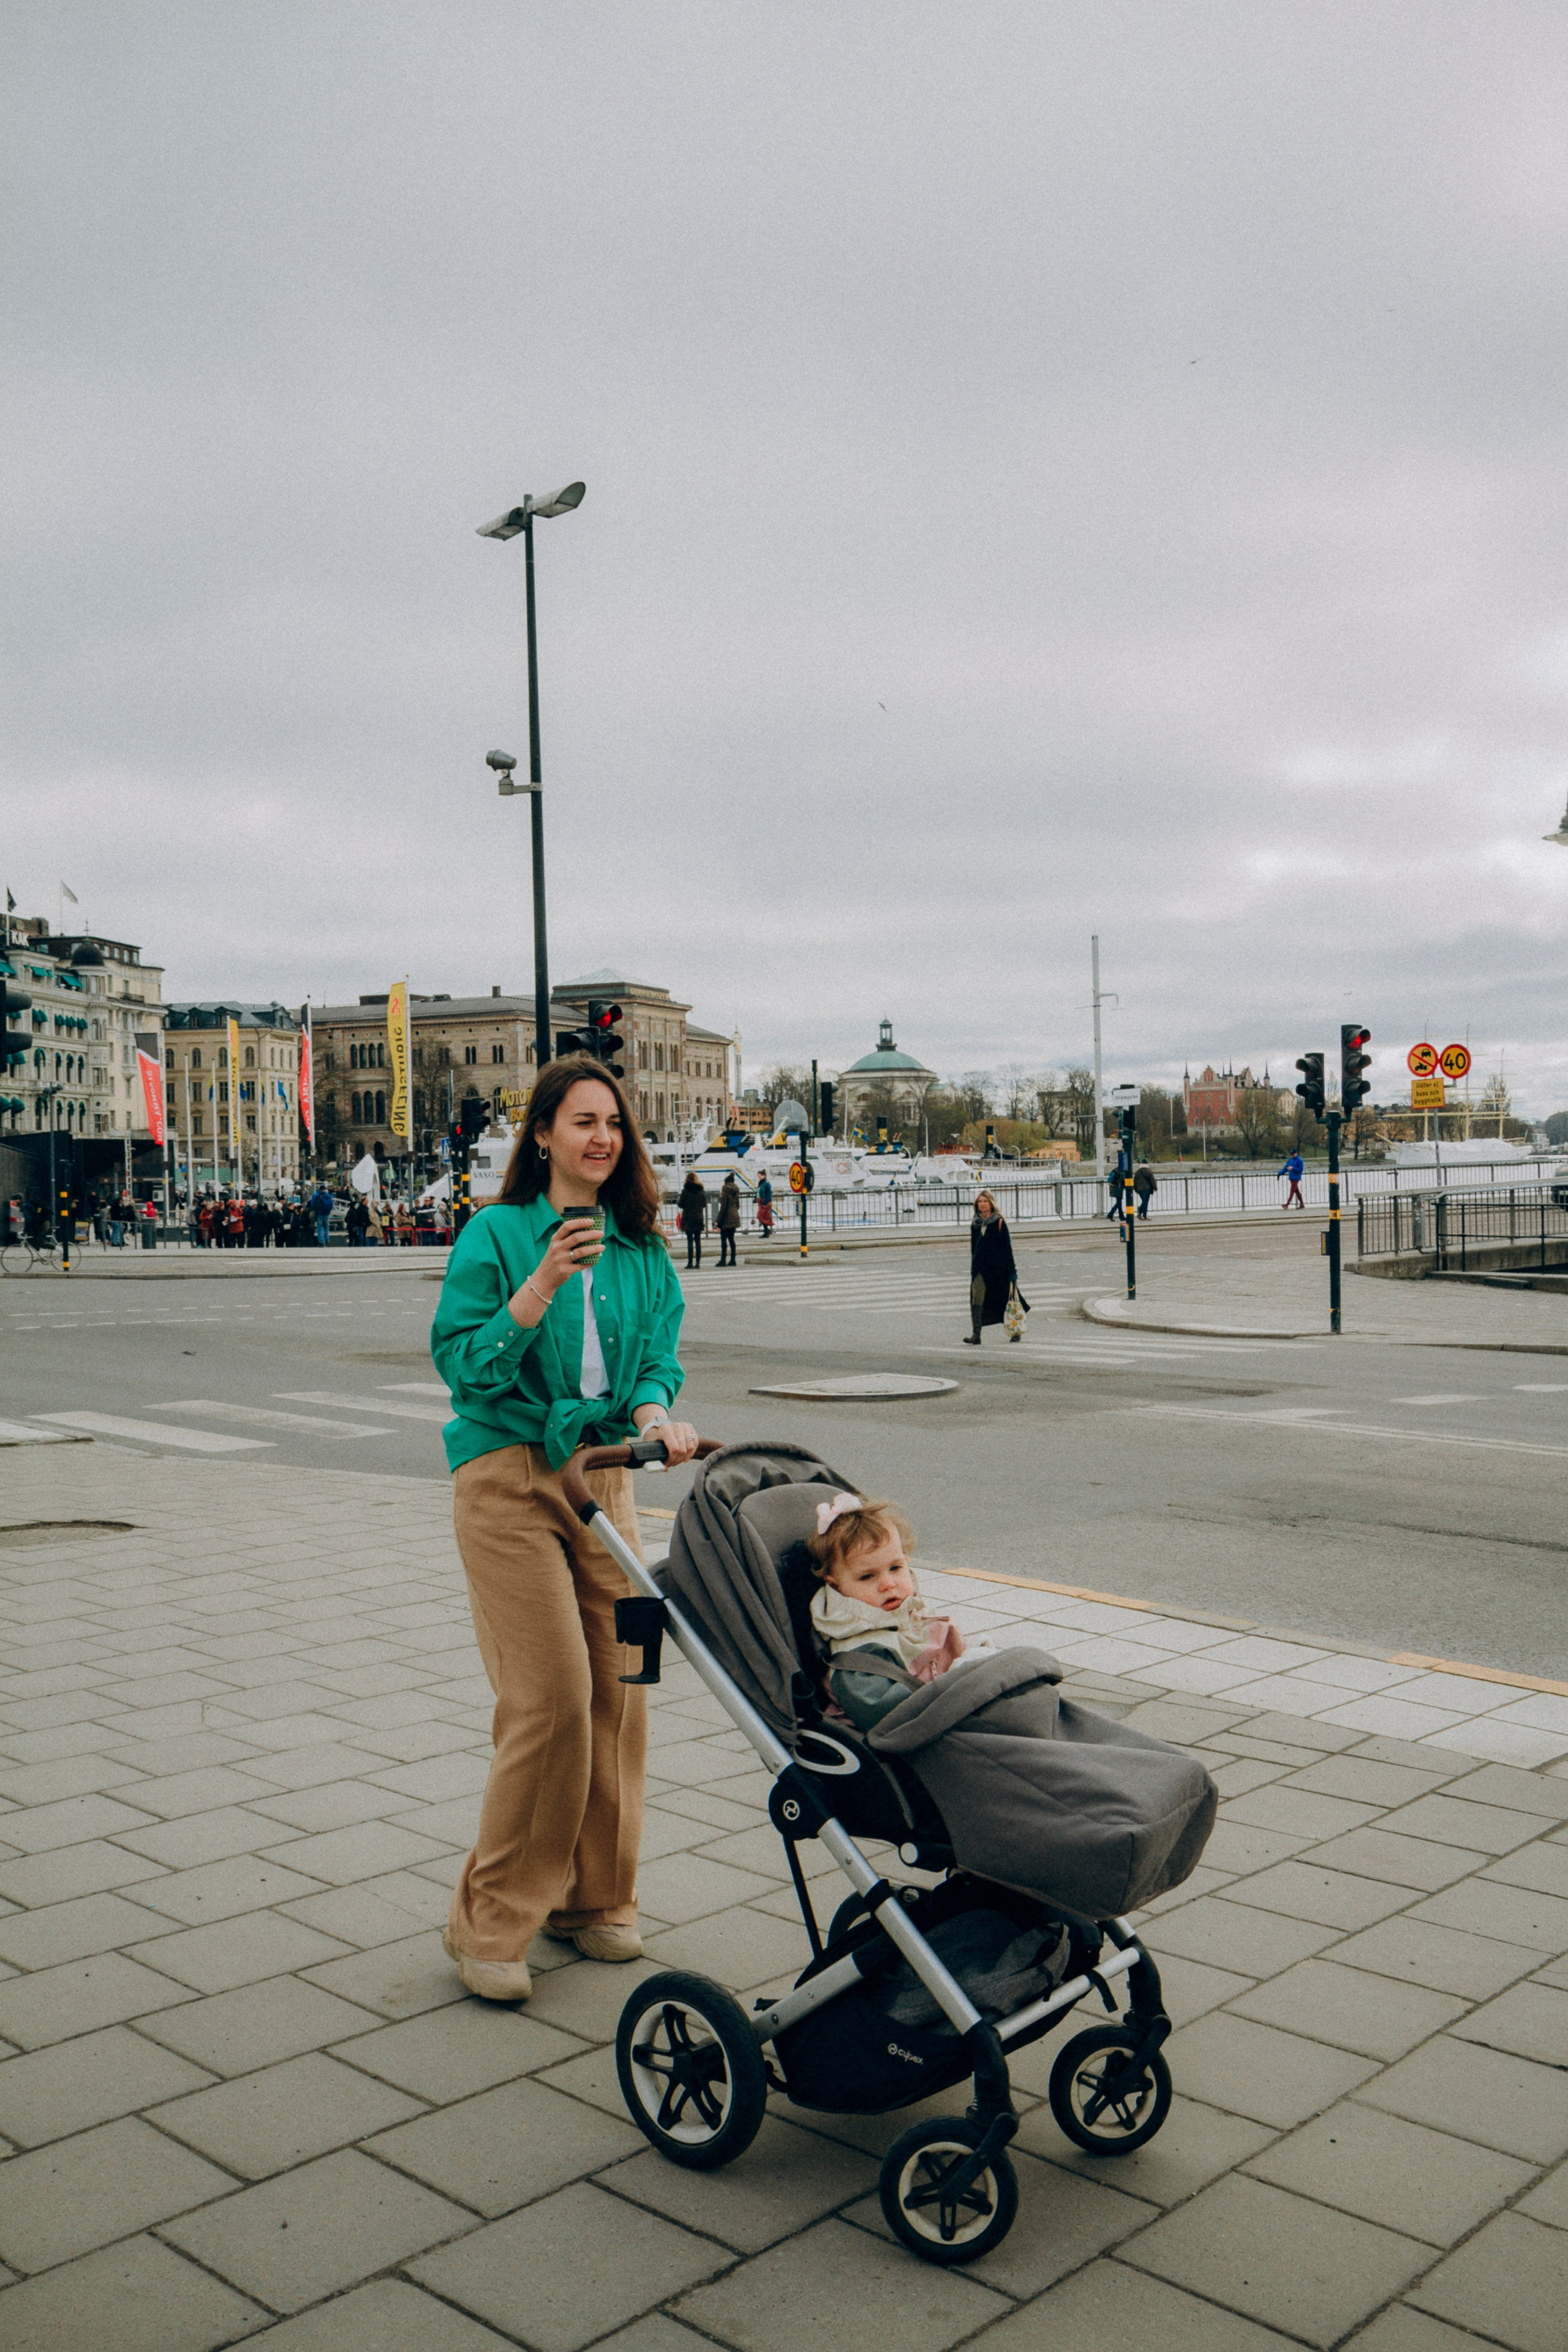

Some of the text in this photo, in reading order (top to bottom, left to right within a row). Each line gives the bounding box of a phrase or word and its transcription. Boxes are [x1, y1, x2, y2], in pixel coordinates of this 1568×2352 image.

[11, 930, 29, 946] KAK
[1444, 1052, 1466, 1070] 40
[791, 1170, 802, 1185] 40
[897, 2049, 924, 2065] cybex
